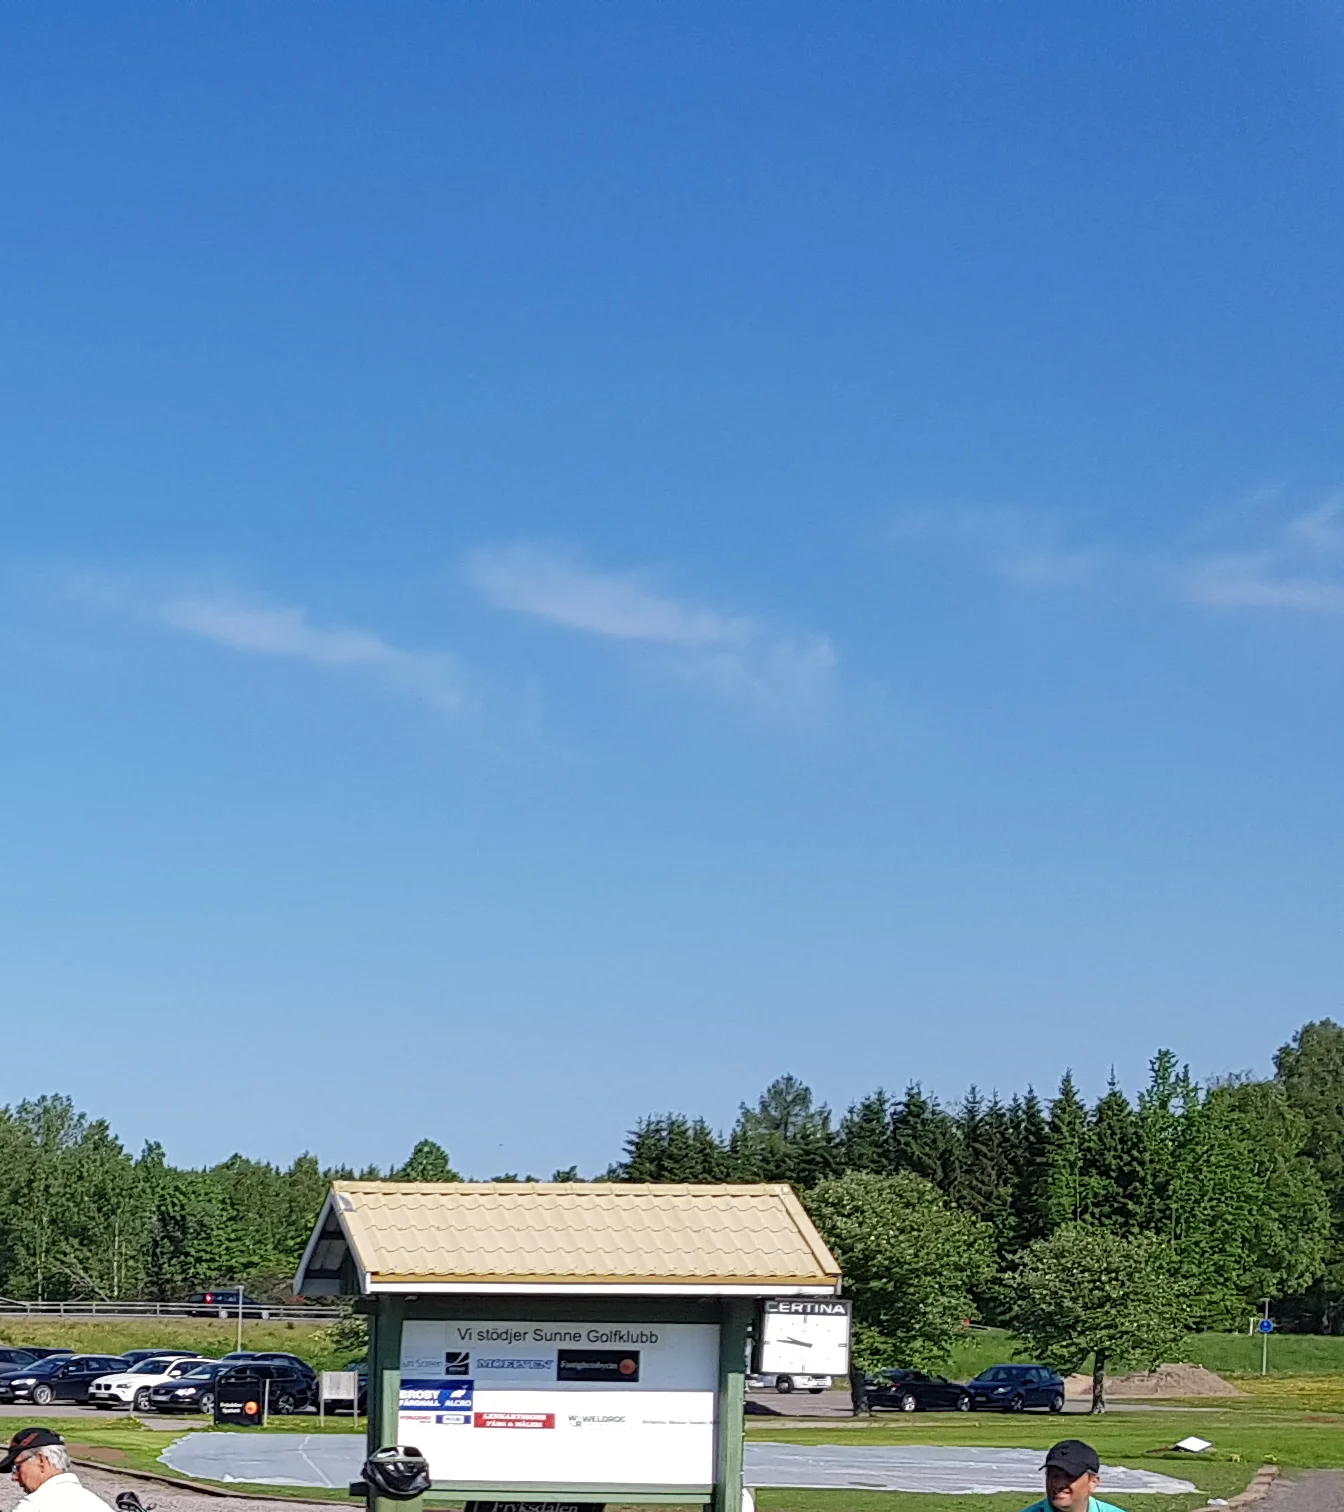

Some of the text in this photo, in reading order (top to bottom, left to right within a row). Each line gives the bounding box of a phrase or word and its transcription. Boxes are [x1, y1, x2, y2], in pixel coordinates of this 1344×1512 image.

[765, 1302, 846, 1314] CERTINA
[457, 1328, 659, 1344] Vi stödjer Sunne Golfklubb
